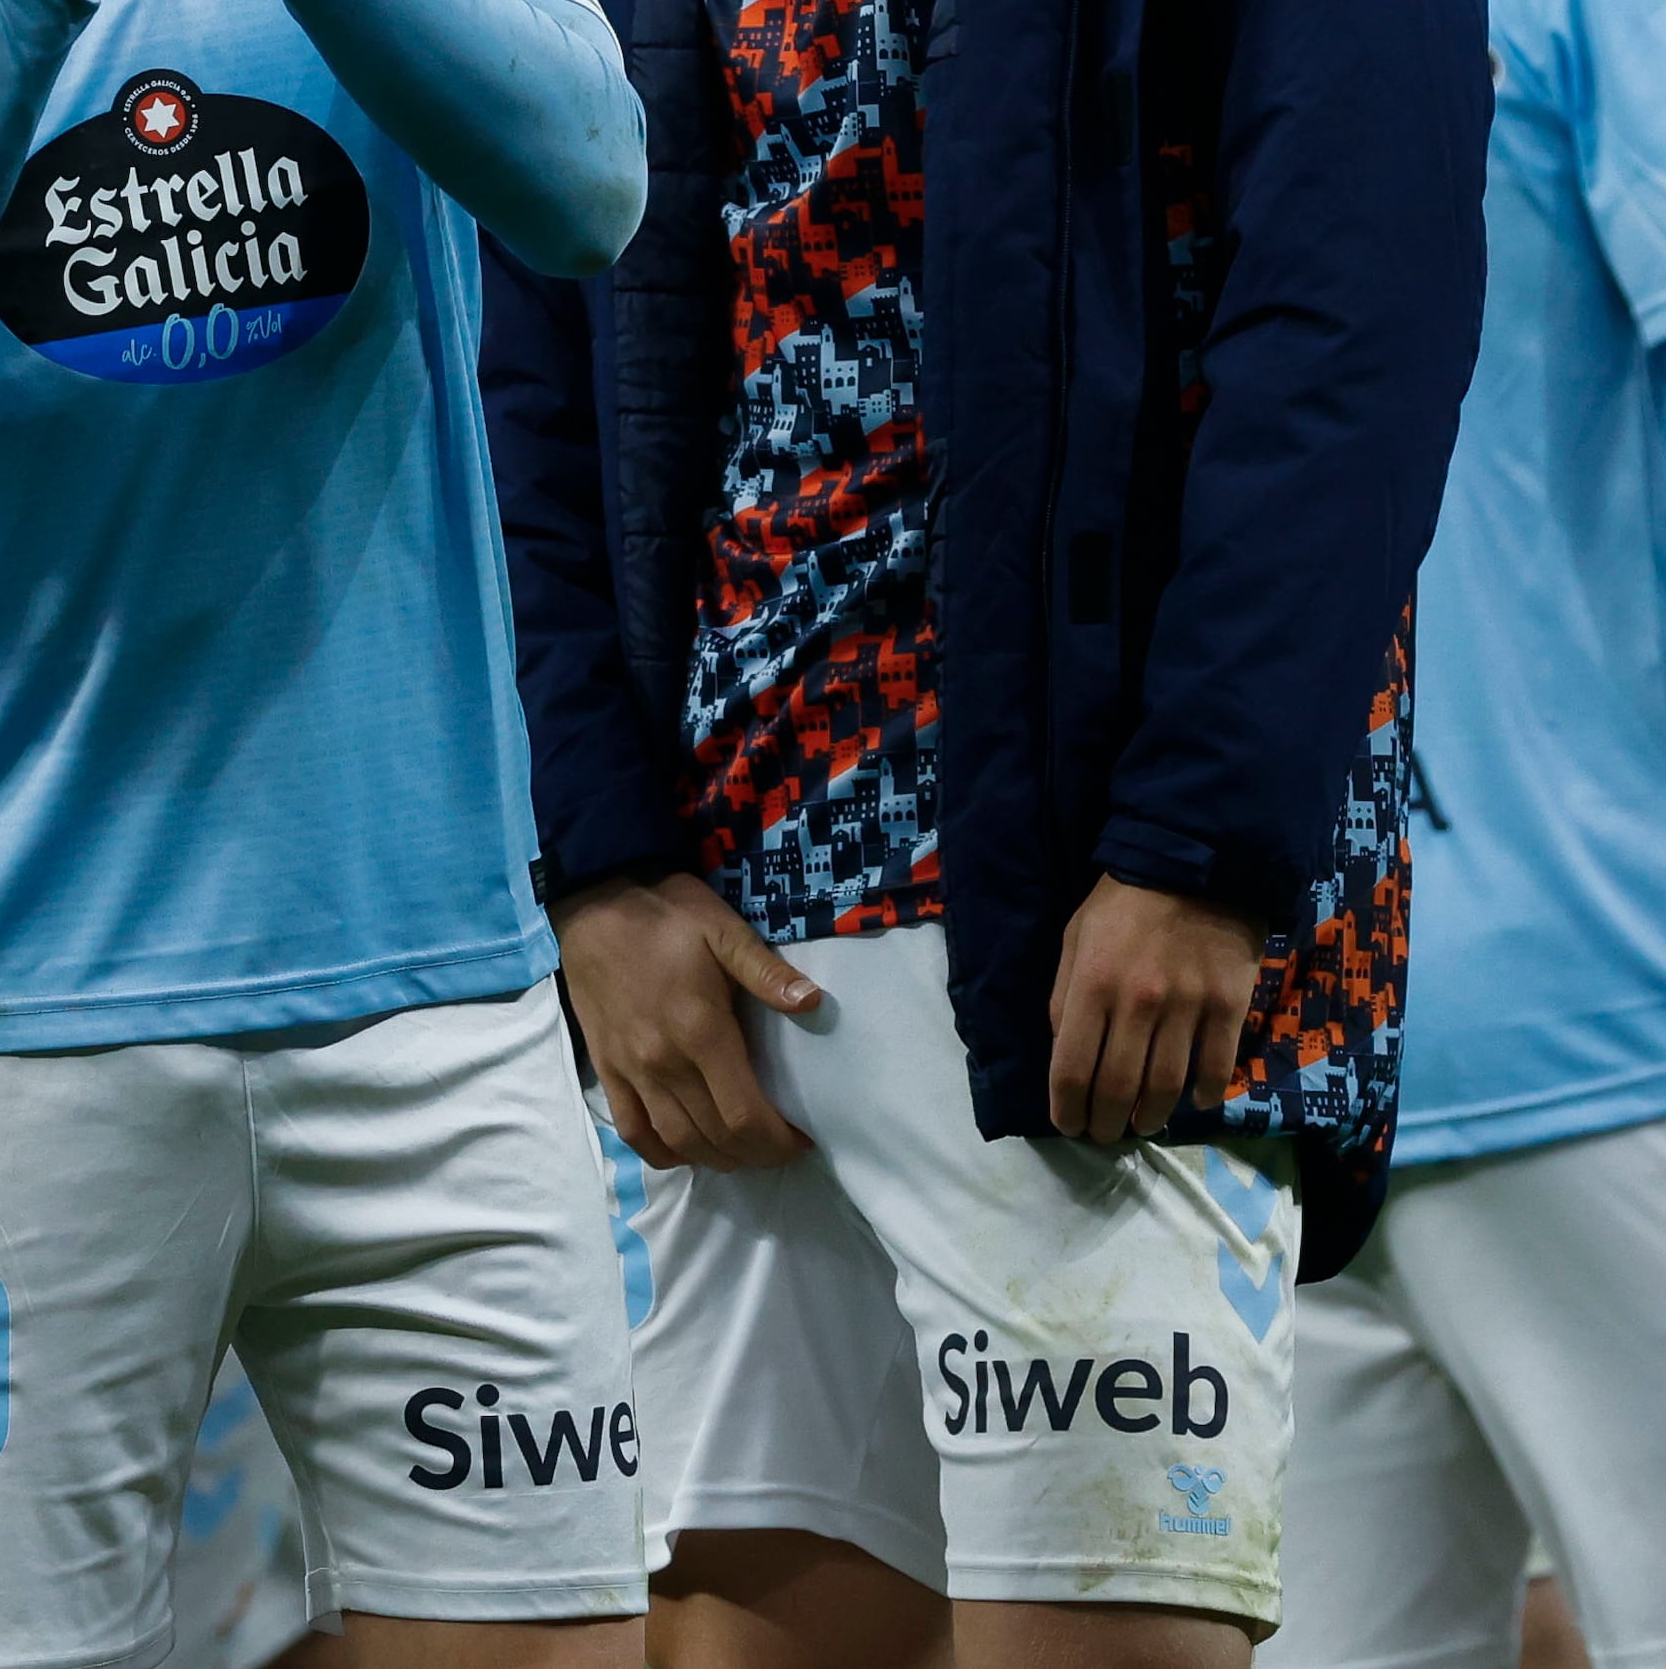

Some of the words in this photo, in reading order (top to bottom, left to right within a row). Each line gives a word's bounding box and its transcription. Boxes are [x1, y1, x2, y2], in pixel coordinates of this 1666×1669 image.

[124, 82, 150, 113] ESTRELLA
[150, 79, 181, 92] GALICIA
[124, 126, 169, 156] CERVECEROS
[170, 133, 193, 154] DESDE
[43, 146, 309, 248] Estrella
[62, 219, 309, 317] Galicia
[121, 337, 157, 366] alc.
[161, 302, 240, 370] 0,0
[938, 1328, 1233, 1441] Siweb
[405, 1384, 640, 1490] Siwe
[1159, 1509, 1231, 1536] hummel
